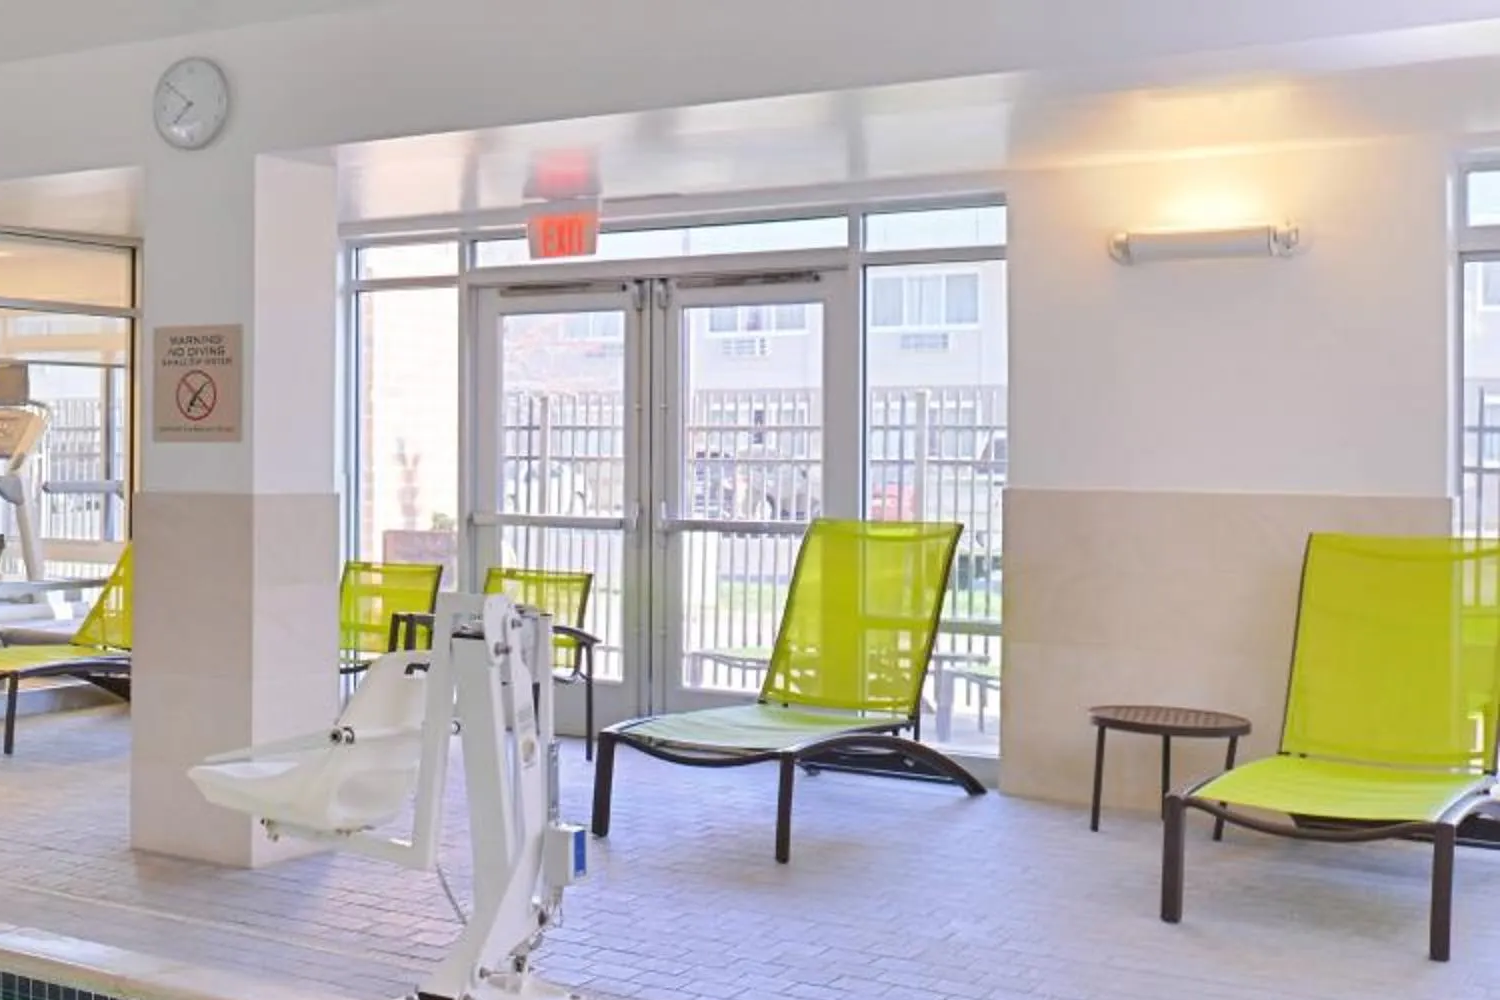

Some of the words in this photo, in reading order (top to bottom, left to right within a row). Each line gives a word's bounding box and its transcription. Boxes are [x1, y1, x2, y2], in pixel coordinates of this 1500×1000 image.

[542, 217, 585, 257] EXIT
[168, 347, 185, 357] NO
[187, 345, 226, 357] DIVING
